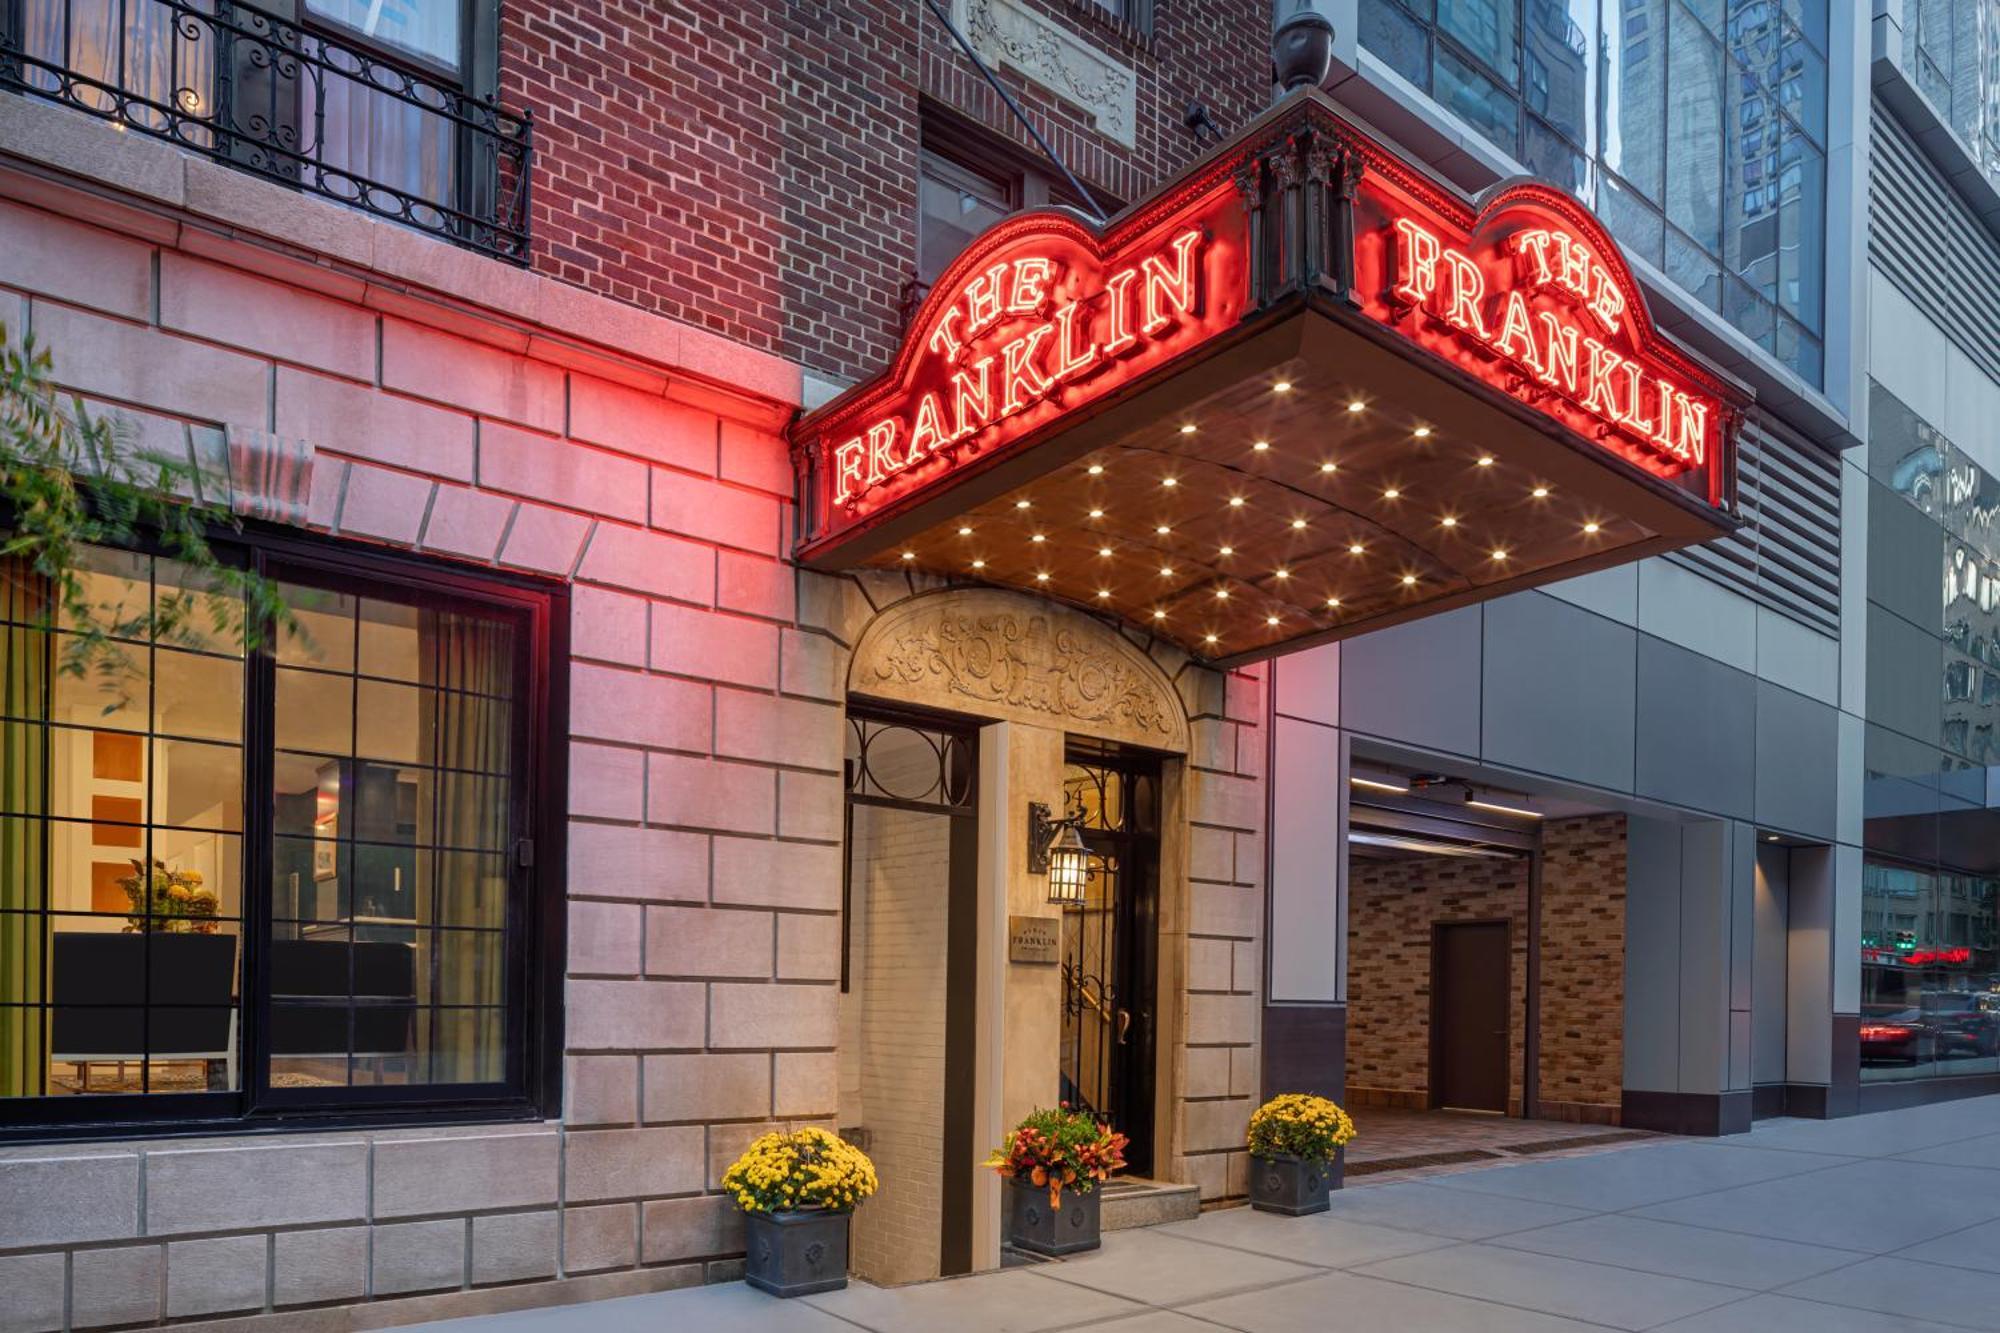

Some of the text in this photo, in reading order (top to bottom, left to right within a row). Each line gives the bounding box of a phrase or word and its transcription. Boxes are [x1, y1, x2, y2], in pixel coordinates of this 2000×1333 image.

[833, 230, 1201, 505] FRANKLIN
[930, 257, 1051, 363] THE
[1397, 218, 1709, 464] FRANKLIN
[1519, 230, 1625, 333] THE
